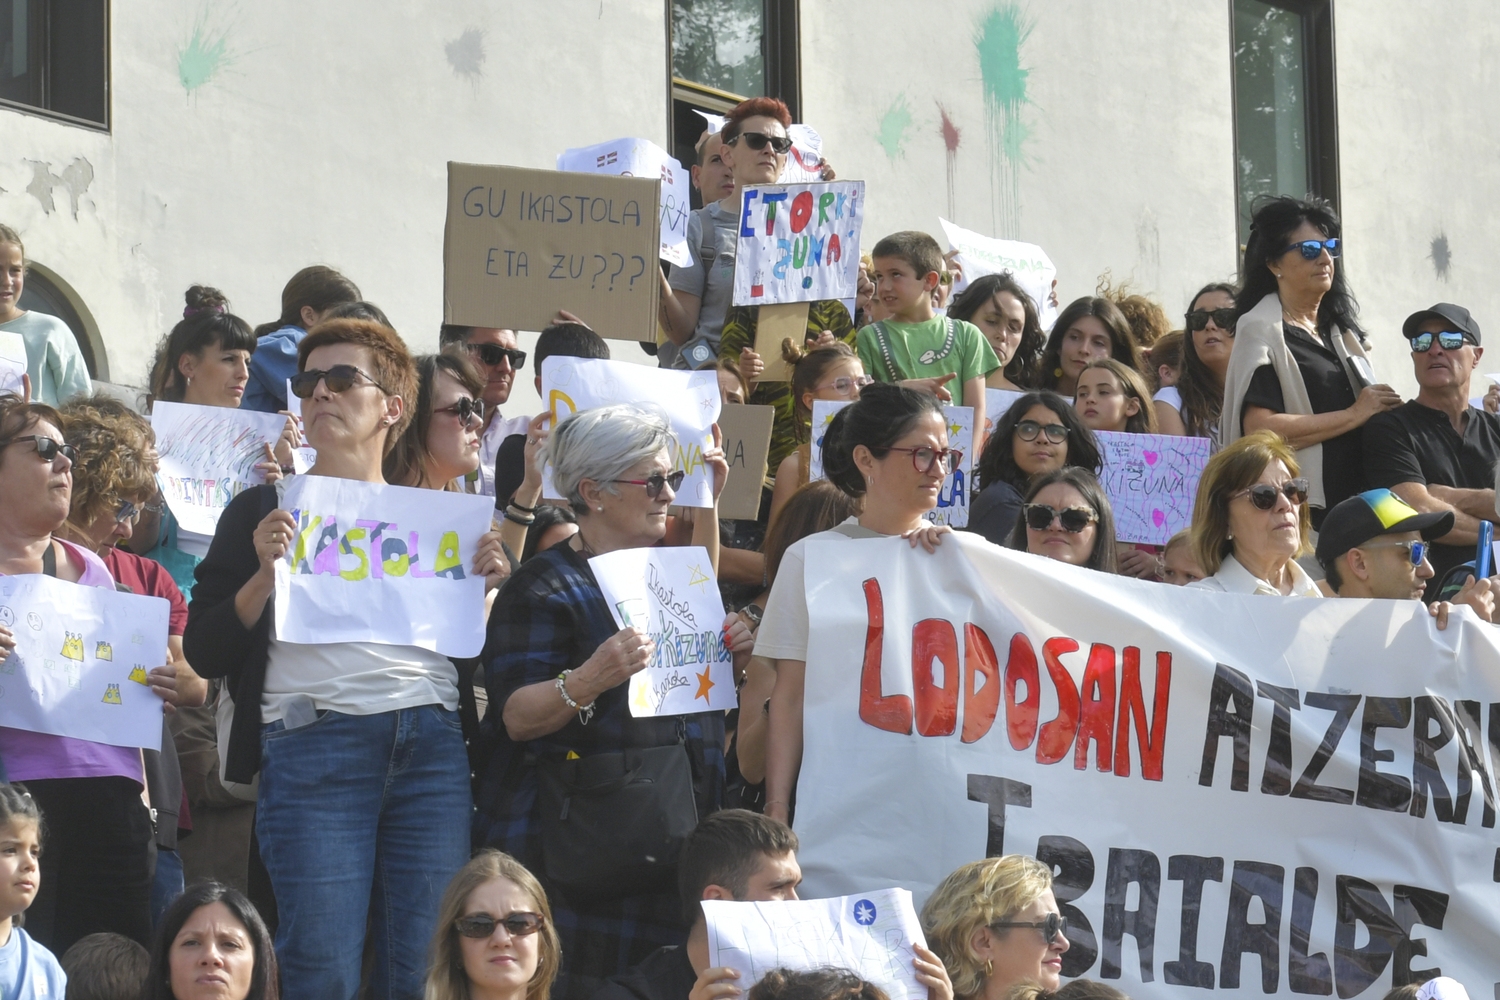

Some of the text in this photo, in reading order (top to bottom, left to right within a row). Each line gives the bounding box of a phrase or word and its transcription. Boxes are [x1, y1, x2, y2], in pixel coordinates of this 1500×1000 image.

[464, 184, 641, 228] GU IKASTOLA
[661, 195, 688, 238] RA
[486, 248, 645, 292] ETA ZU???
[290, 508, 467, 582] KASTOLA
[858, 576, 1172, 781] LODOSAN
